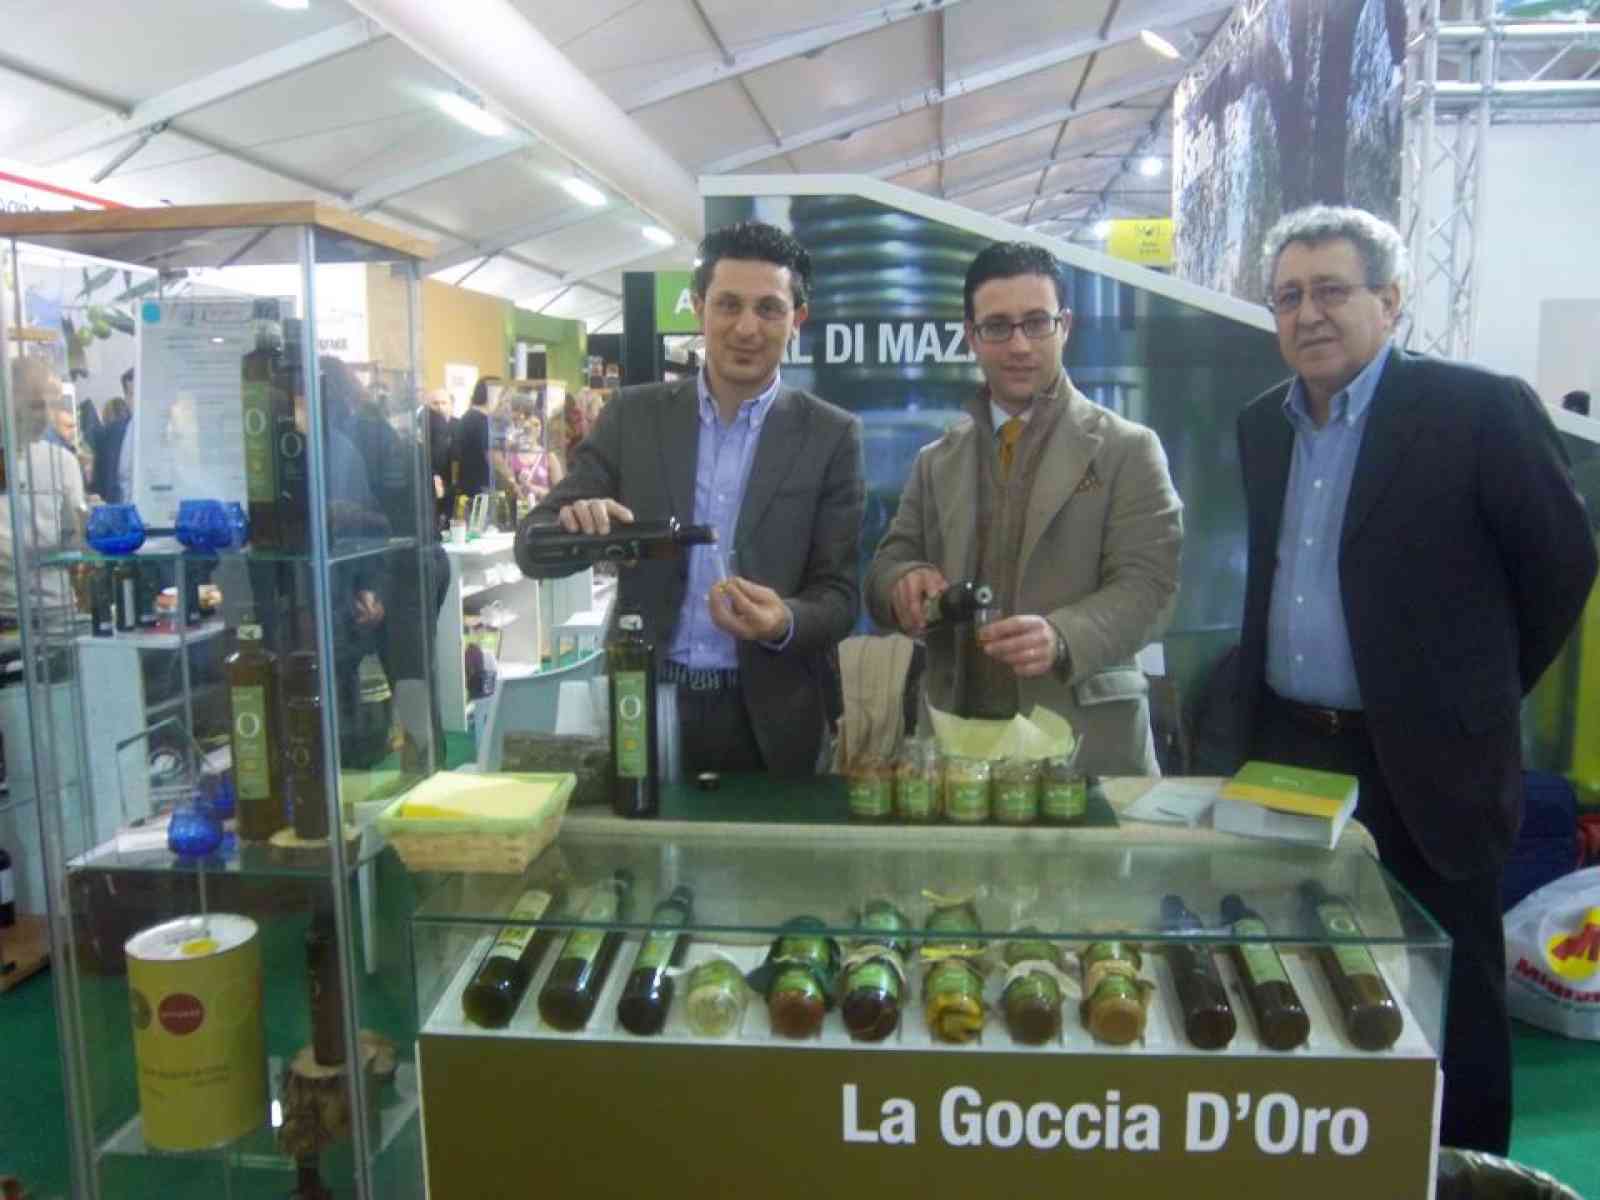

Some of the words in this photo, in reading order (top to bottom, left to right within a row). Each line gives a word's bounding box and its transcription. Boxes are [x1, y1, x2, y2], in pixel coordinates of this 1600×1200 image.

[825, 323, 863, 363] DI
[878, 322, 976, 363] MAZ
[842, 1083, 917, 1145] La
[939, 1085, 1160, 1152] Goccia
